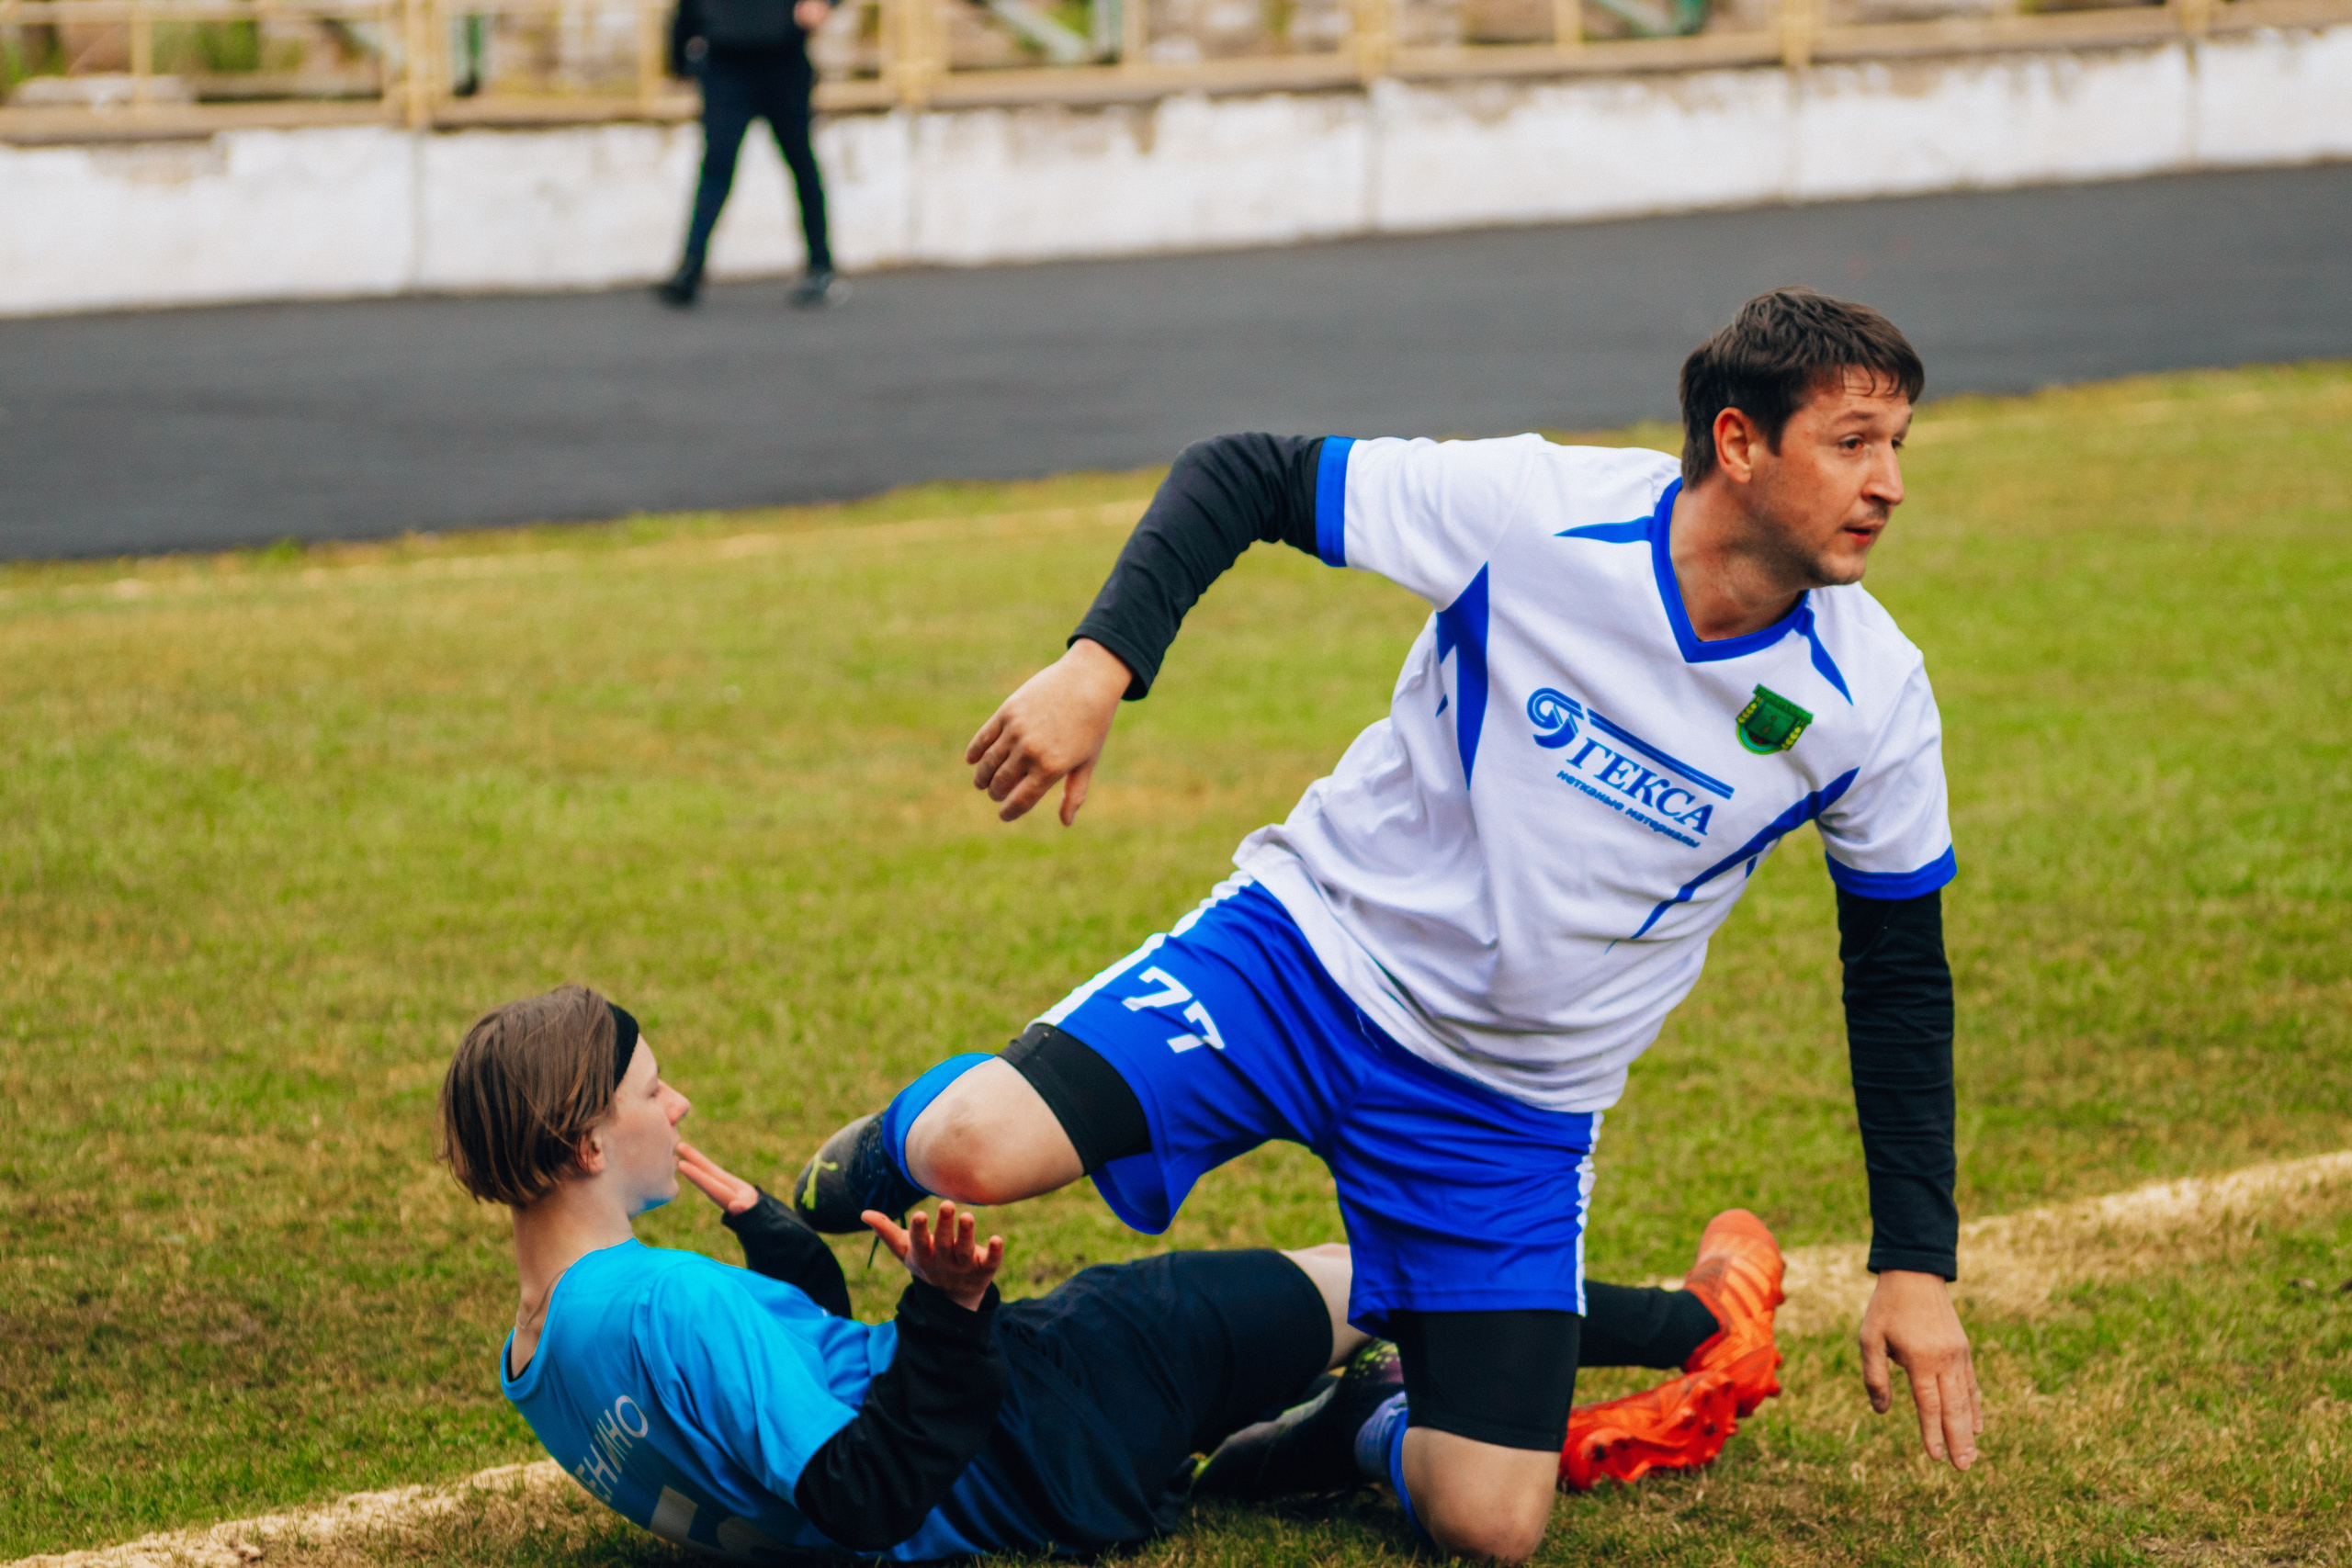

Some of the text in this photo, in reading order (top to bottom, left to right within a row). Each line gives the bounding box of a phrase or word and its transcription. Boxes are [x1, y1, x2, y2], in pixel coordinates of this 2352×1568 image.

[1555, 770, 1625, 812] нетканые
[1566, 737, 1714, 837] ГЕКСА
[1121, 965, 1226, 1054] 77
